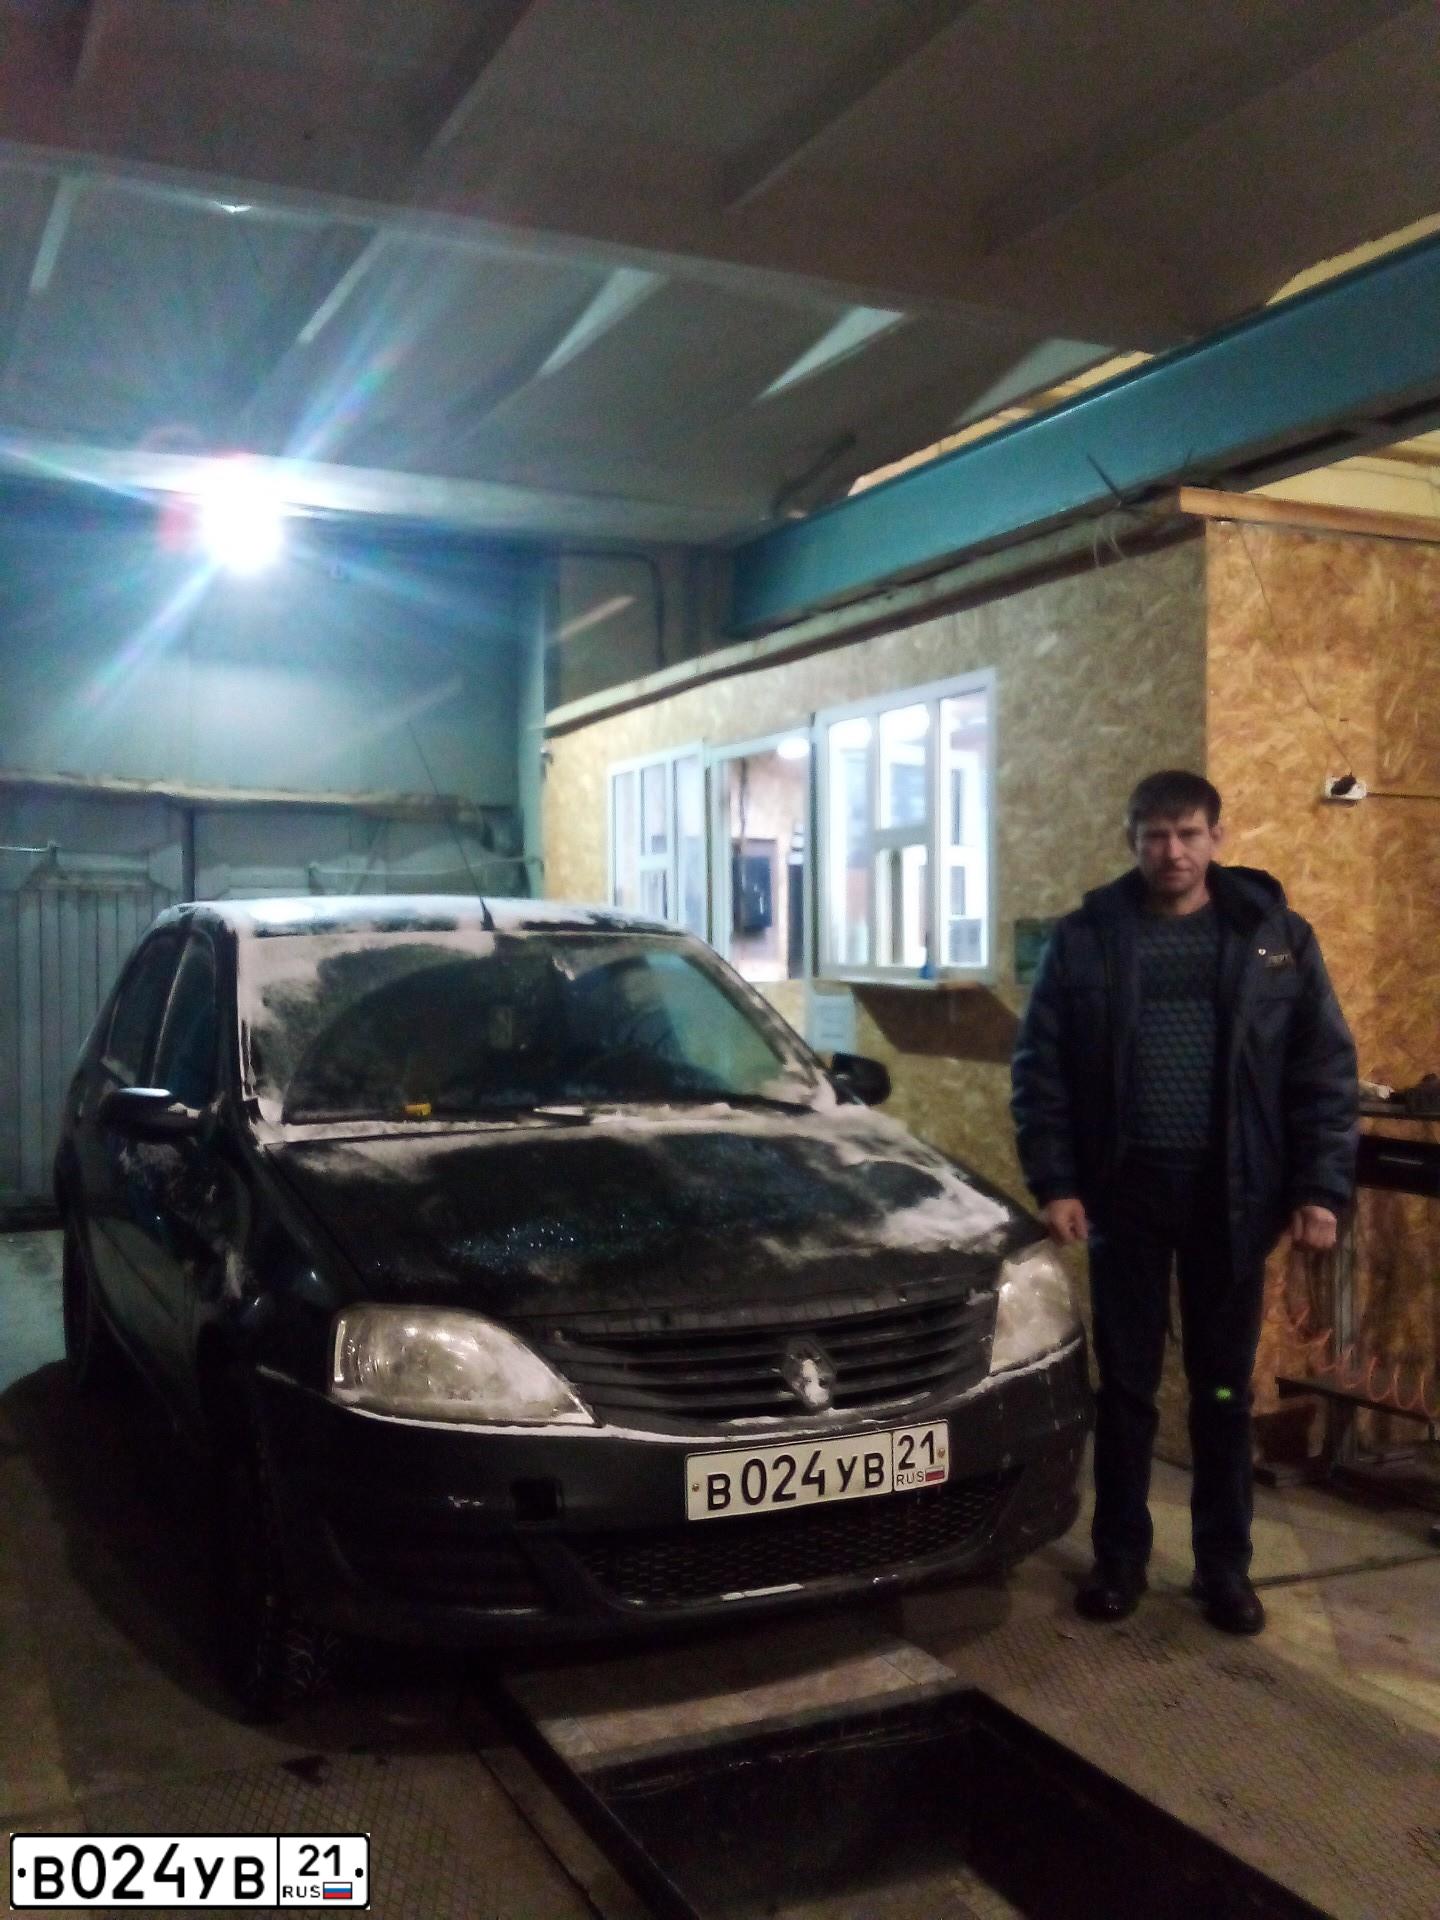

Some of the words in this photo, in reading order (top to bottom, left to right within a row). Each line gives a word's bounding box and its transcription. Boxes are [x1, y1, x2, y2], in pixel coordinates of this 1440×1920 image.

[706, 1450, 885, 1511] В024УВ
[897, 1430, 935, 1470] 21
[896, 1471, 925, 1485] RUS
